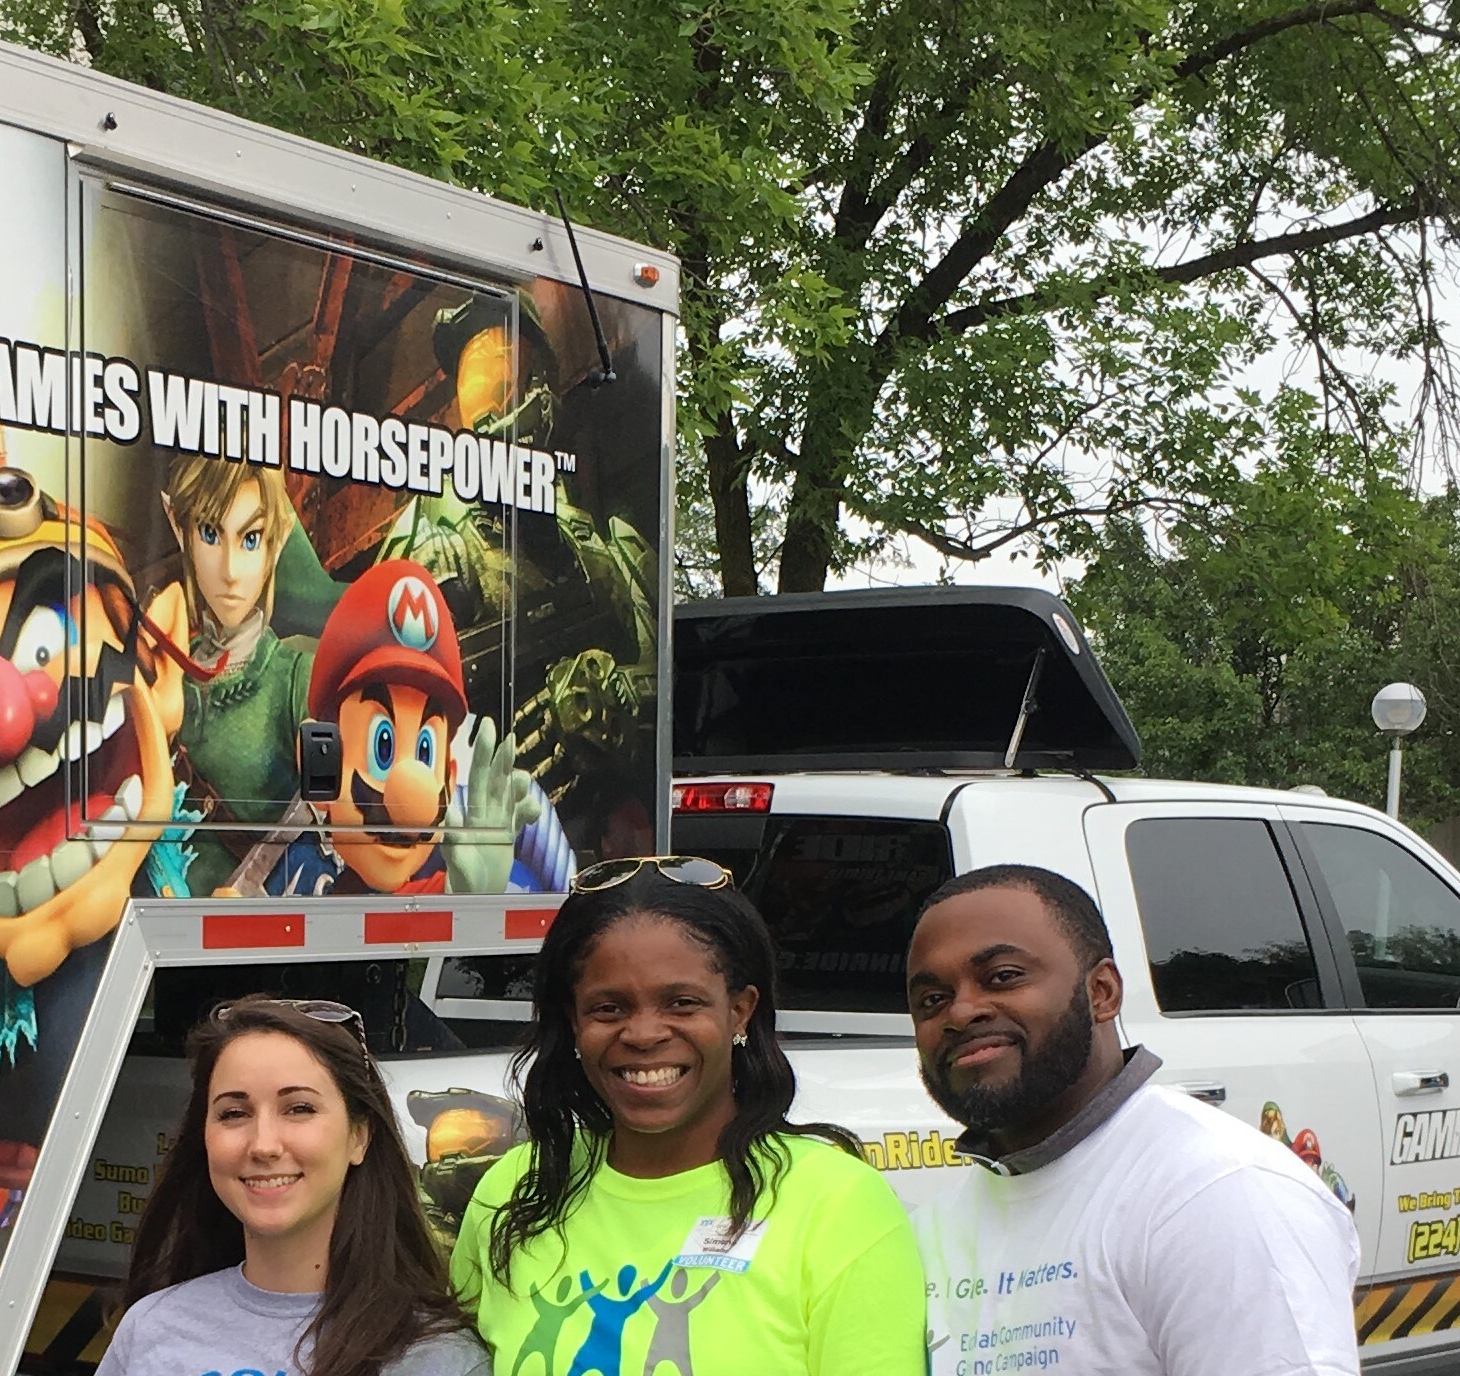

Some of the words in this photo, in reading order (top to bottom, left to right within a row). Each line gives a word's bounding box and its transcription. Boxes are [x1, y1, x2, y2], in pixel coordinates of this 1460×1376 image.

[148, 371, 282, 466] WITH
[94, 1158, 149, 1185] Sumo
[1398, 1194, 1418, 1213] We
[1419, 1190, 1452, 1211] Bring
[66, 1217, 107, 1242] ideo
[678, 1255, 747, 1272] VOLUNTEER
[998, 1271, 1015, 1294] It
